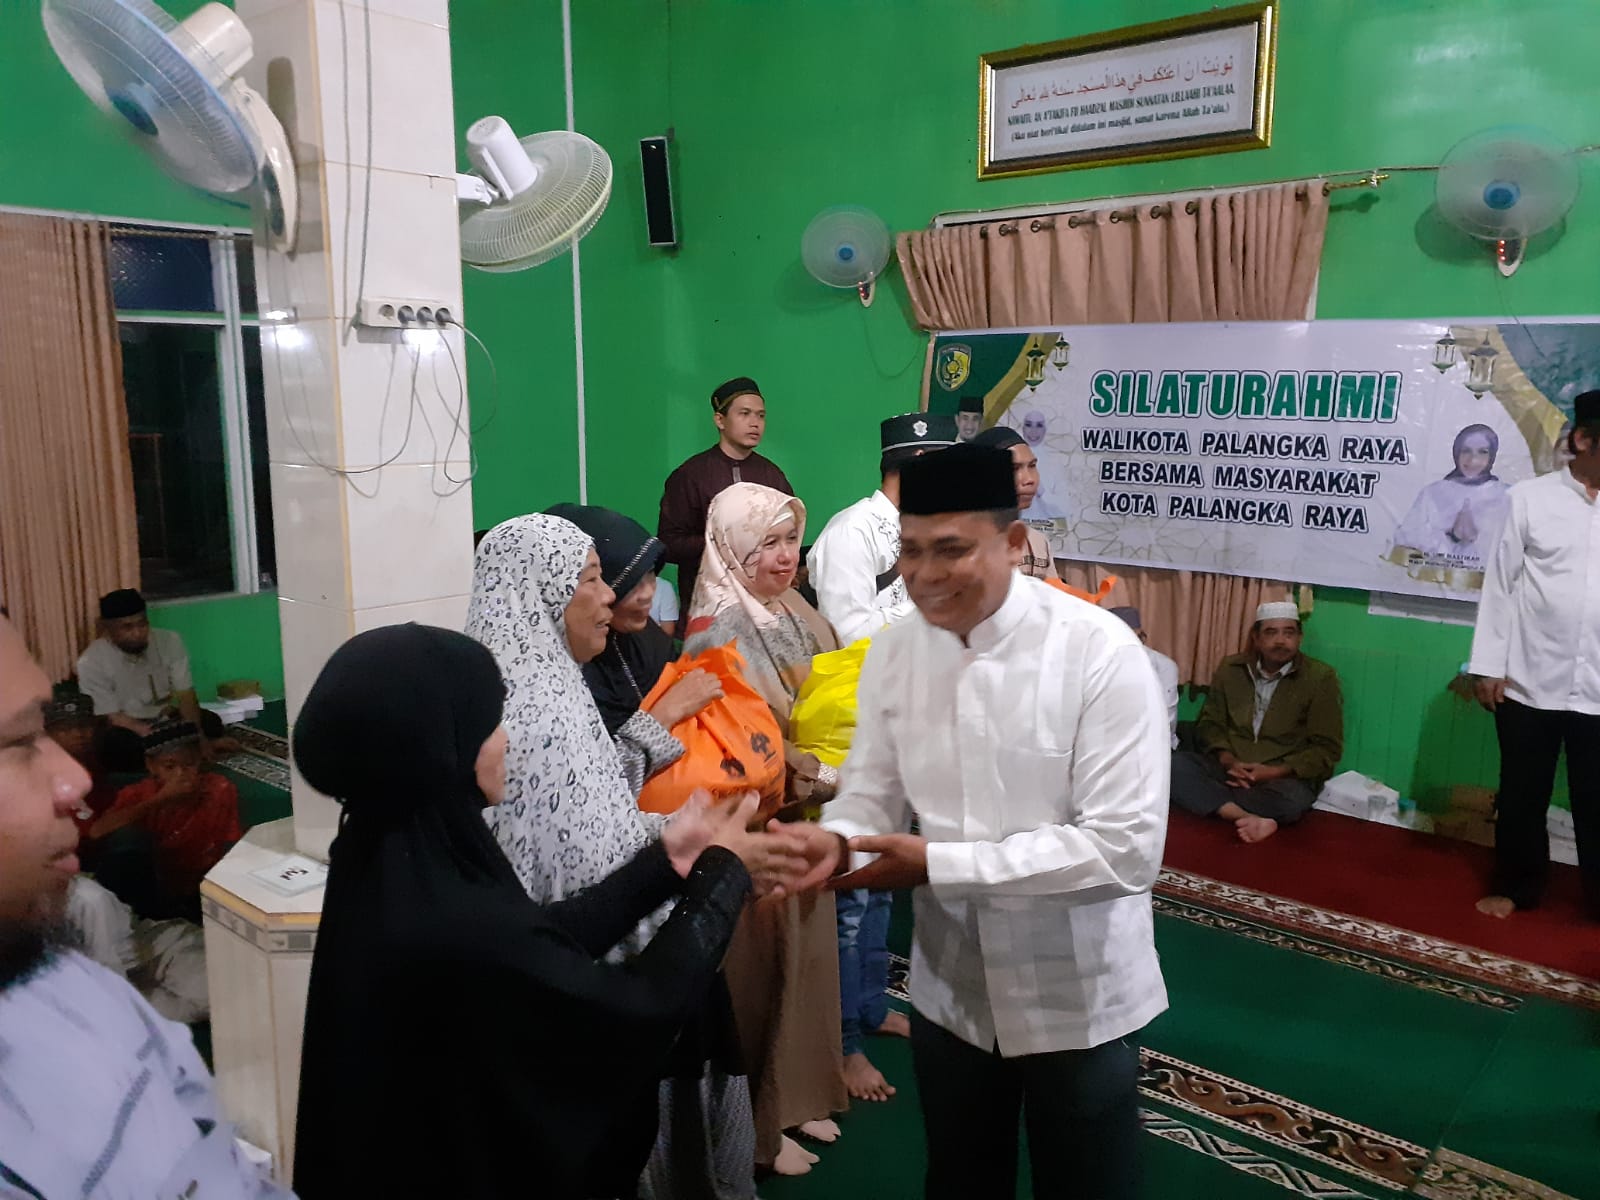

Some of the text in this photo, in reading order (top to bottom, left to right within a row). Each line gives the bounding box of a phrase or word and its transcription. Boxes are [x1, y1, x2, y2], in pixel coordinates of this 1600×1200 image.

[1090, 370, 1402, 422] SILATURAHMI
[1082, 428, 1408, 463] WALIKOTA PALANGKA RAYA
[1100, 460, 1379, 497] BERSAMA MASYARAKAT
[1101, 491, 1368, 532] KOTA PALANGKA RAYA
